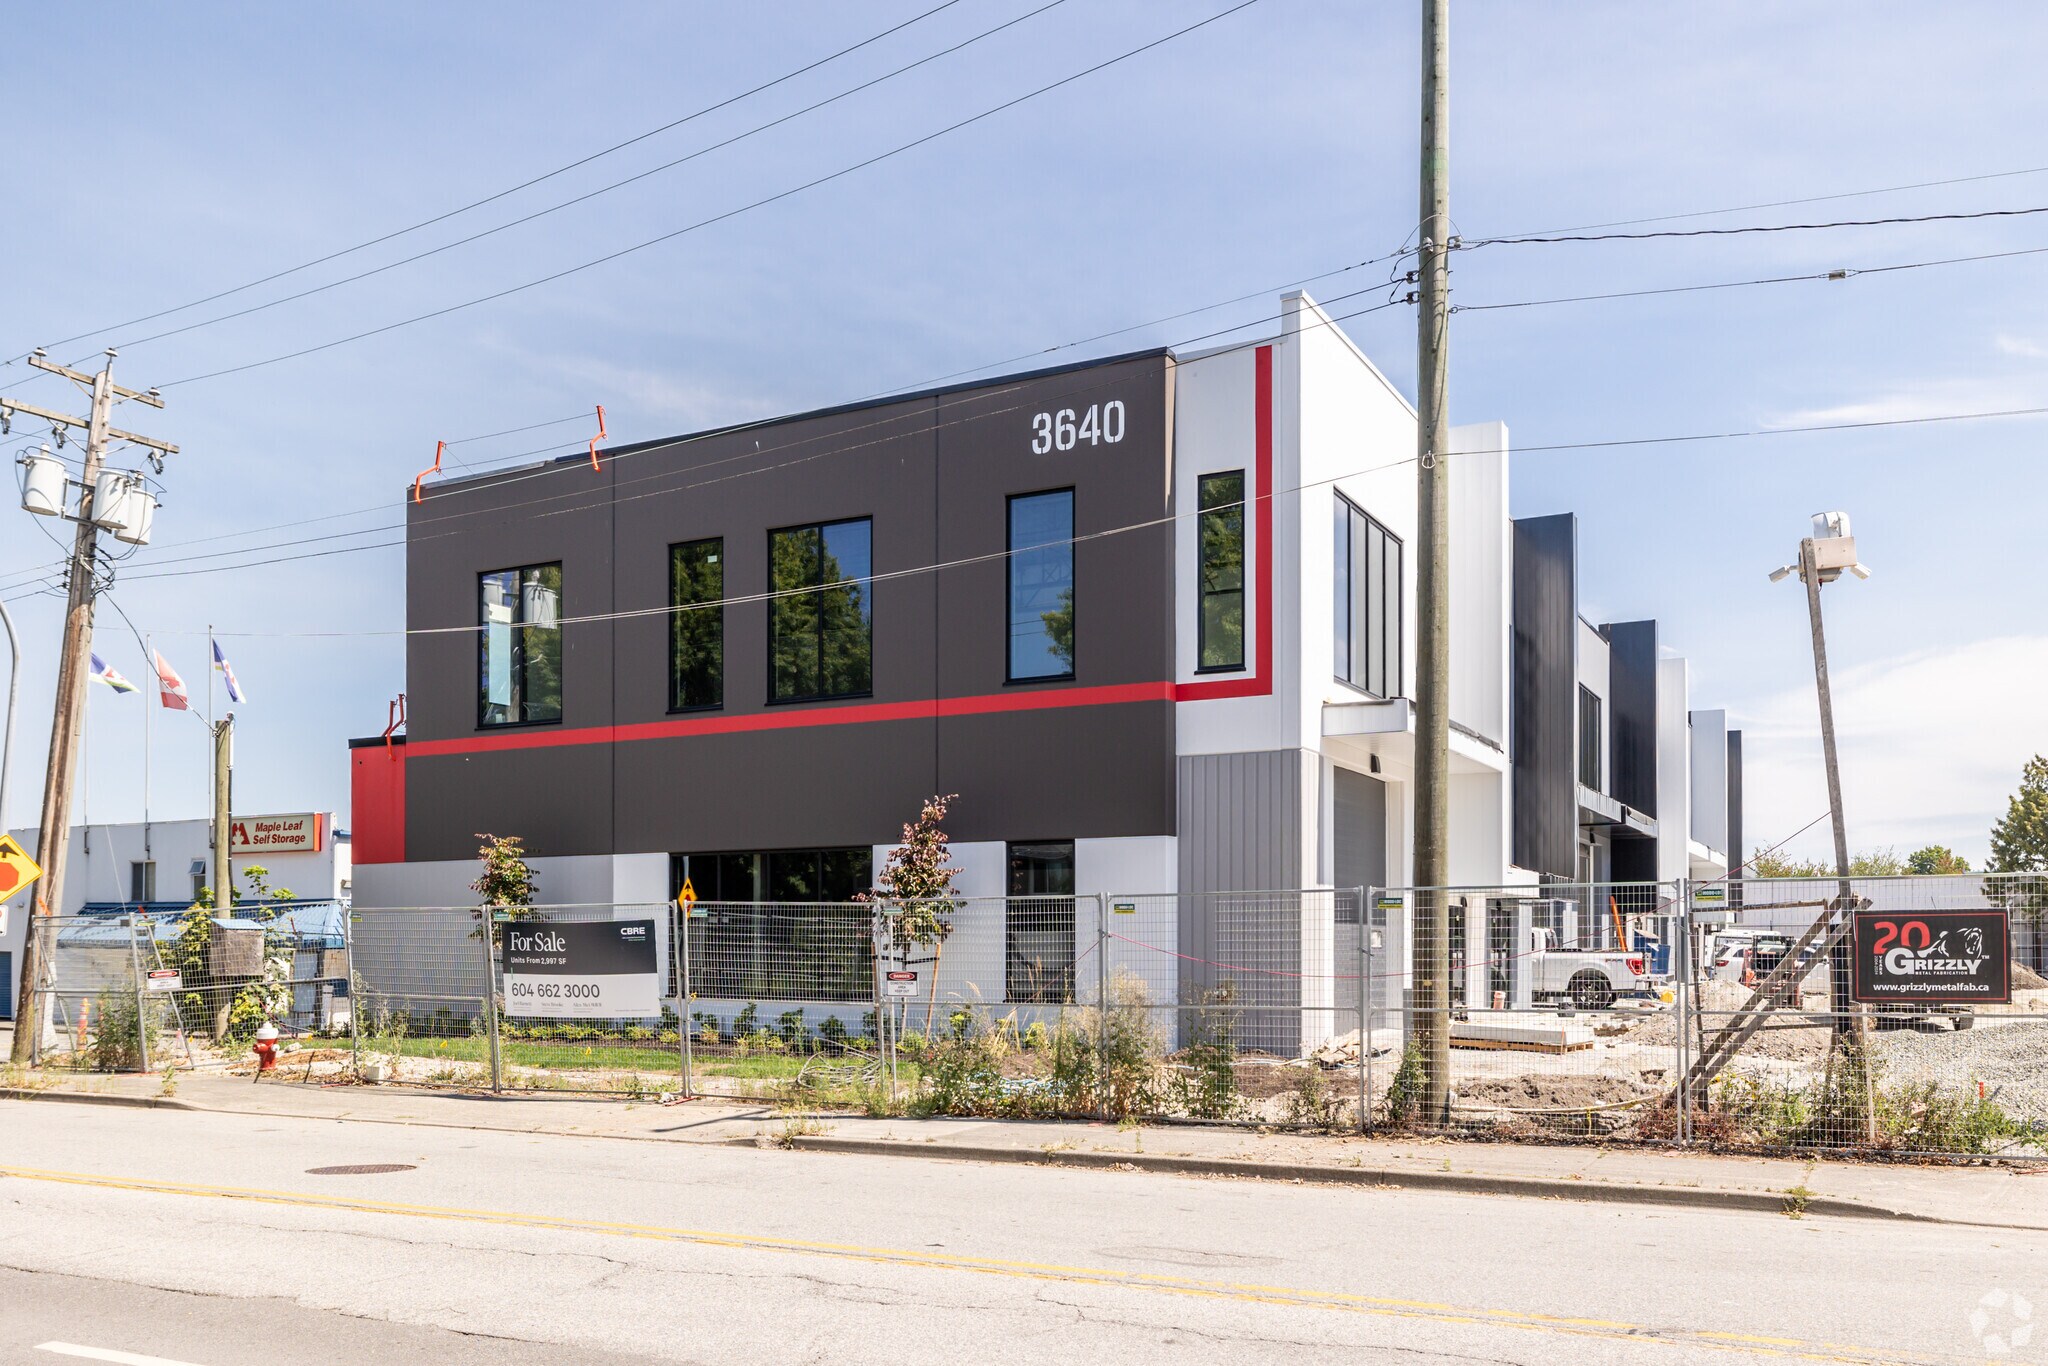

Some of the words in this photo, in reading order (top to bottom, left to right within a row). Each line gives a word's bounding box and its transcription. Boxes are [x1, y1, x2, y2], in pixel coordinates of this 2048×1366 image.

[1032, 400, 1125, 454] 3640
[255, 821, 281, 834] Maple
[282, 820, 303, 831] Leaf
[253, 834, 270, 844] Self
[271, 833, 306, 844] Storage
[620, 926, 646, 935] CBRE
[1873, 920, 1931, 954] 20
[510, 931, 533, 951] For
[534, 931, 566, 952] Sale
[510, 956, 525, 964] Units
[541, 957, 557, 965] 2,997
[1884, 947, 1982, 976] GRIZZLY
[511, 982, 535, 997] 604
[537, 983, 561, 998] 662
[563, 983, 600, 998] 3000
[1873, 982, 1990, 993] www.grizzlymetalfab.ca
